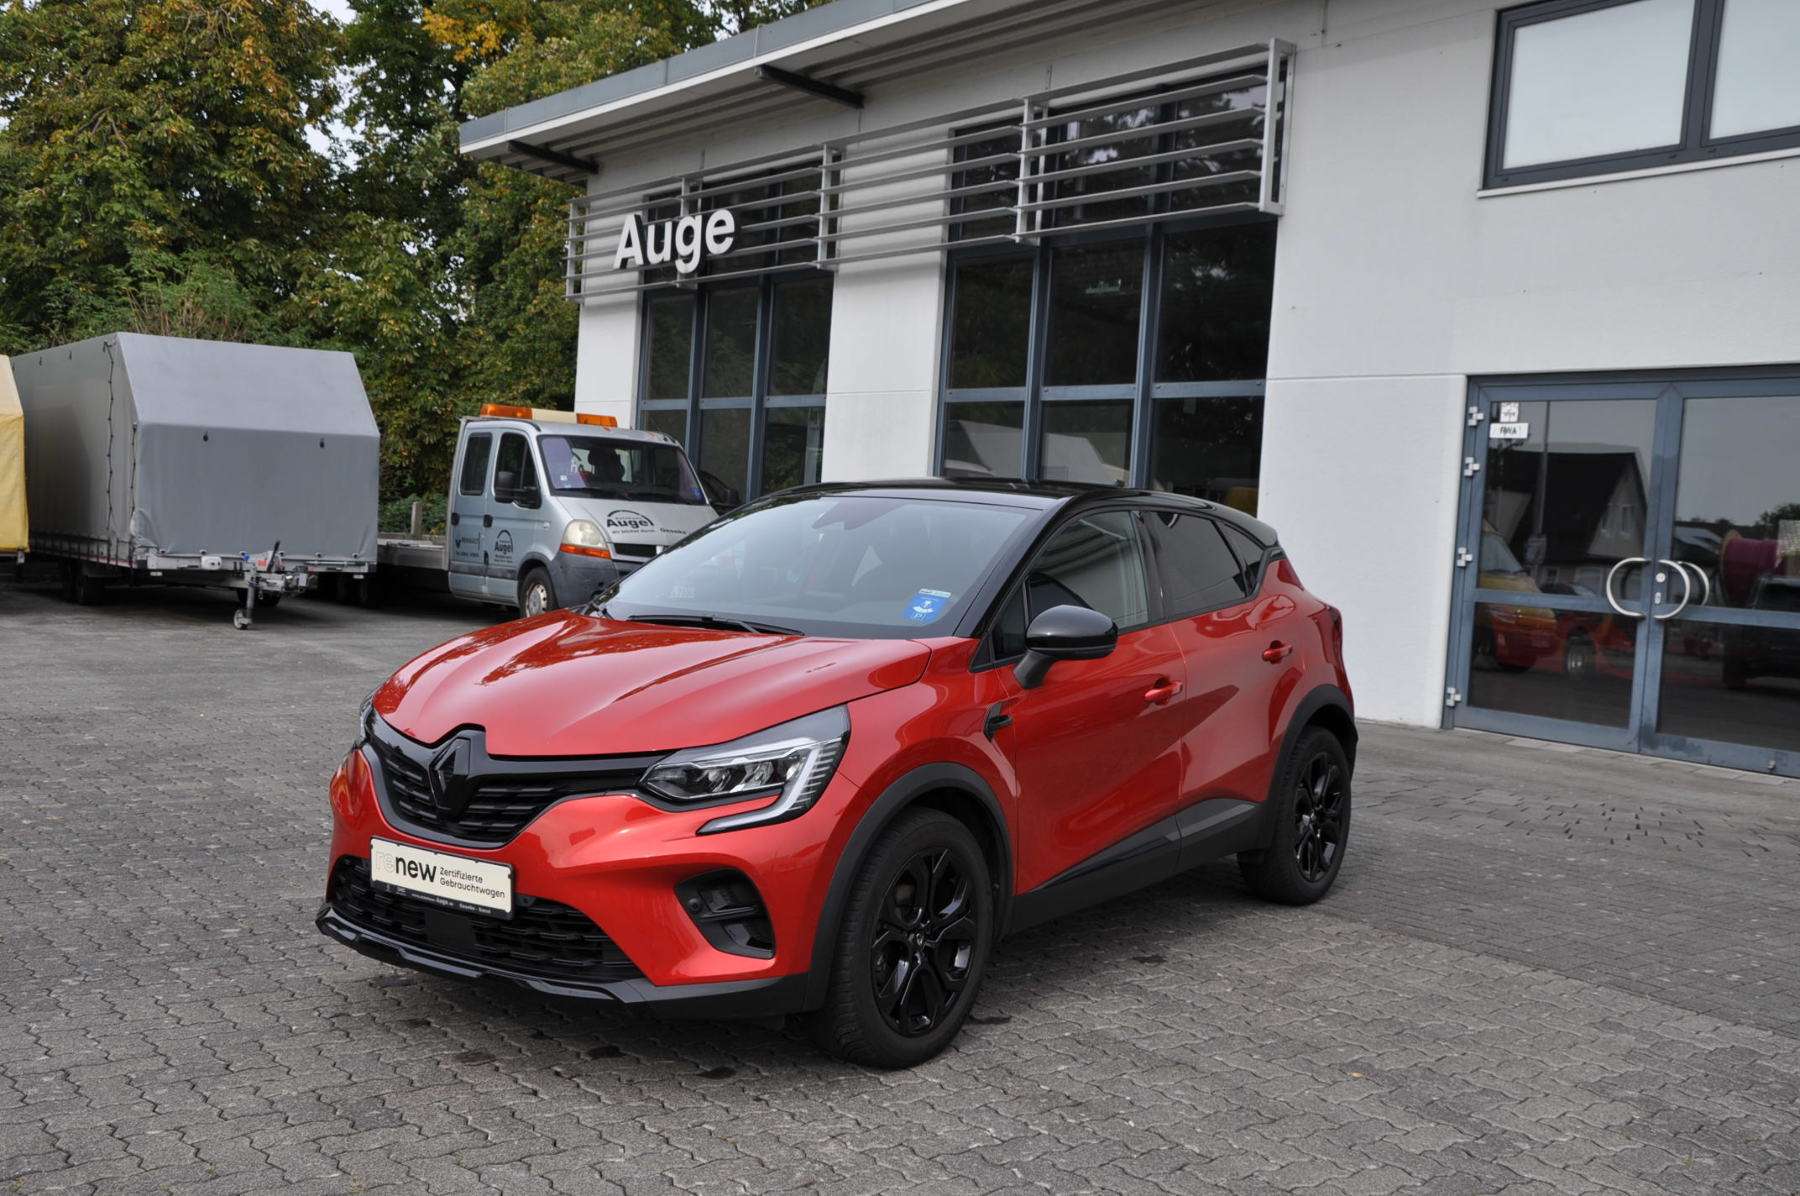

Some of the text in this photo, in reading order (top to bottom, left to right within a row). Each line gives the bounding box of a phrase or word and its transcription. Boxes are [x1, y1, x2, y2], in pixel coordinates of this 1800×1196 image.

[613, 208, 735, 274] Auge
[606, 518, 649, 529] Auge
[439, 867, 483, 884] Zertifizierte
[439, 877, 505, 899] Gebrauchtwagen
